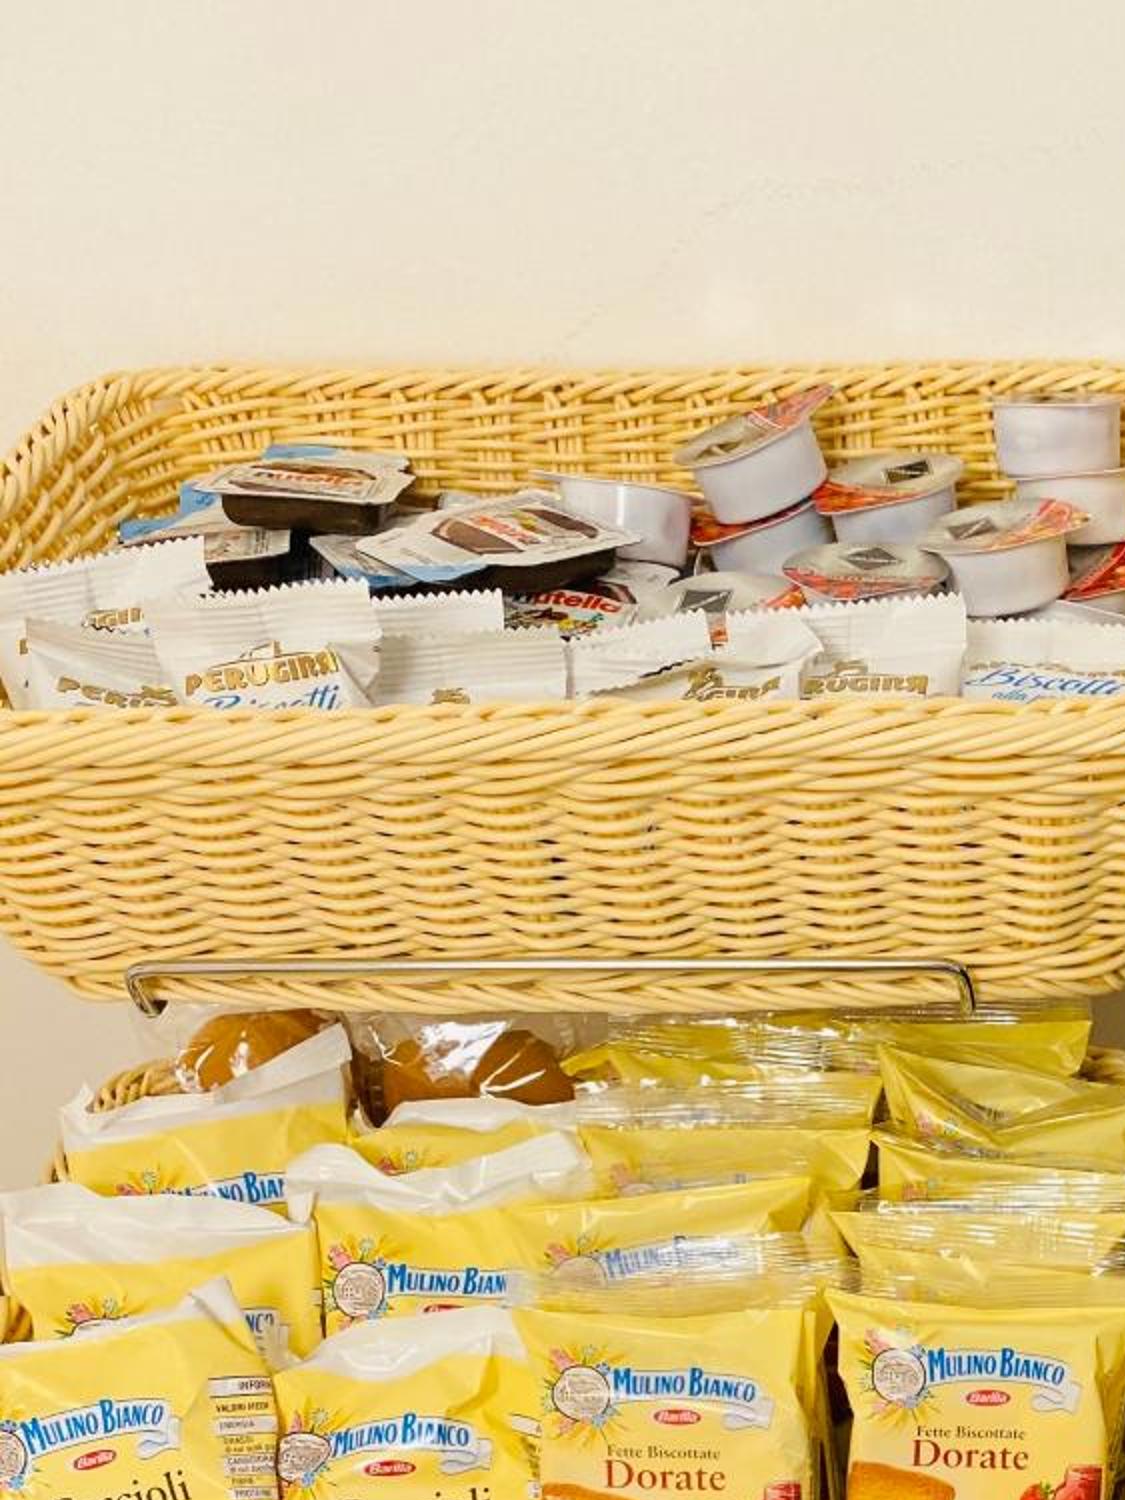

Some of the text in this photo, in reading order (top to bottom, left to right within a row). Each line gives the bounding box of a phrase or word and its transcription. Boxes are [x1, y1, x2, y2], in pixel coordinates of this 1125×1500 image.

[964, 662, 1125, 695] Biscotti
[387, 1263, 507, 1295] MULINO BIAN
[927, 1347, 1065, 1386] MULINO BIANCO
[613, 1366, 756, 1402] MULINO BIANCO
[20, 1399, 165, 1455] MULINO BIANCO
[331, 1412, 470, 1458] MULINO BIANCO
[915, 1424, 1026, 1441] Fette Biscottate
[605, 1444, 721, 1461] Fette Biscottate
[912, 1438, 1030, 1470] Dorate
[604, 1459, 727, 1492] Dorate
